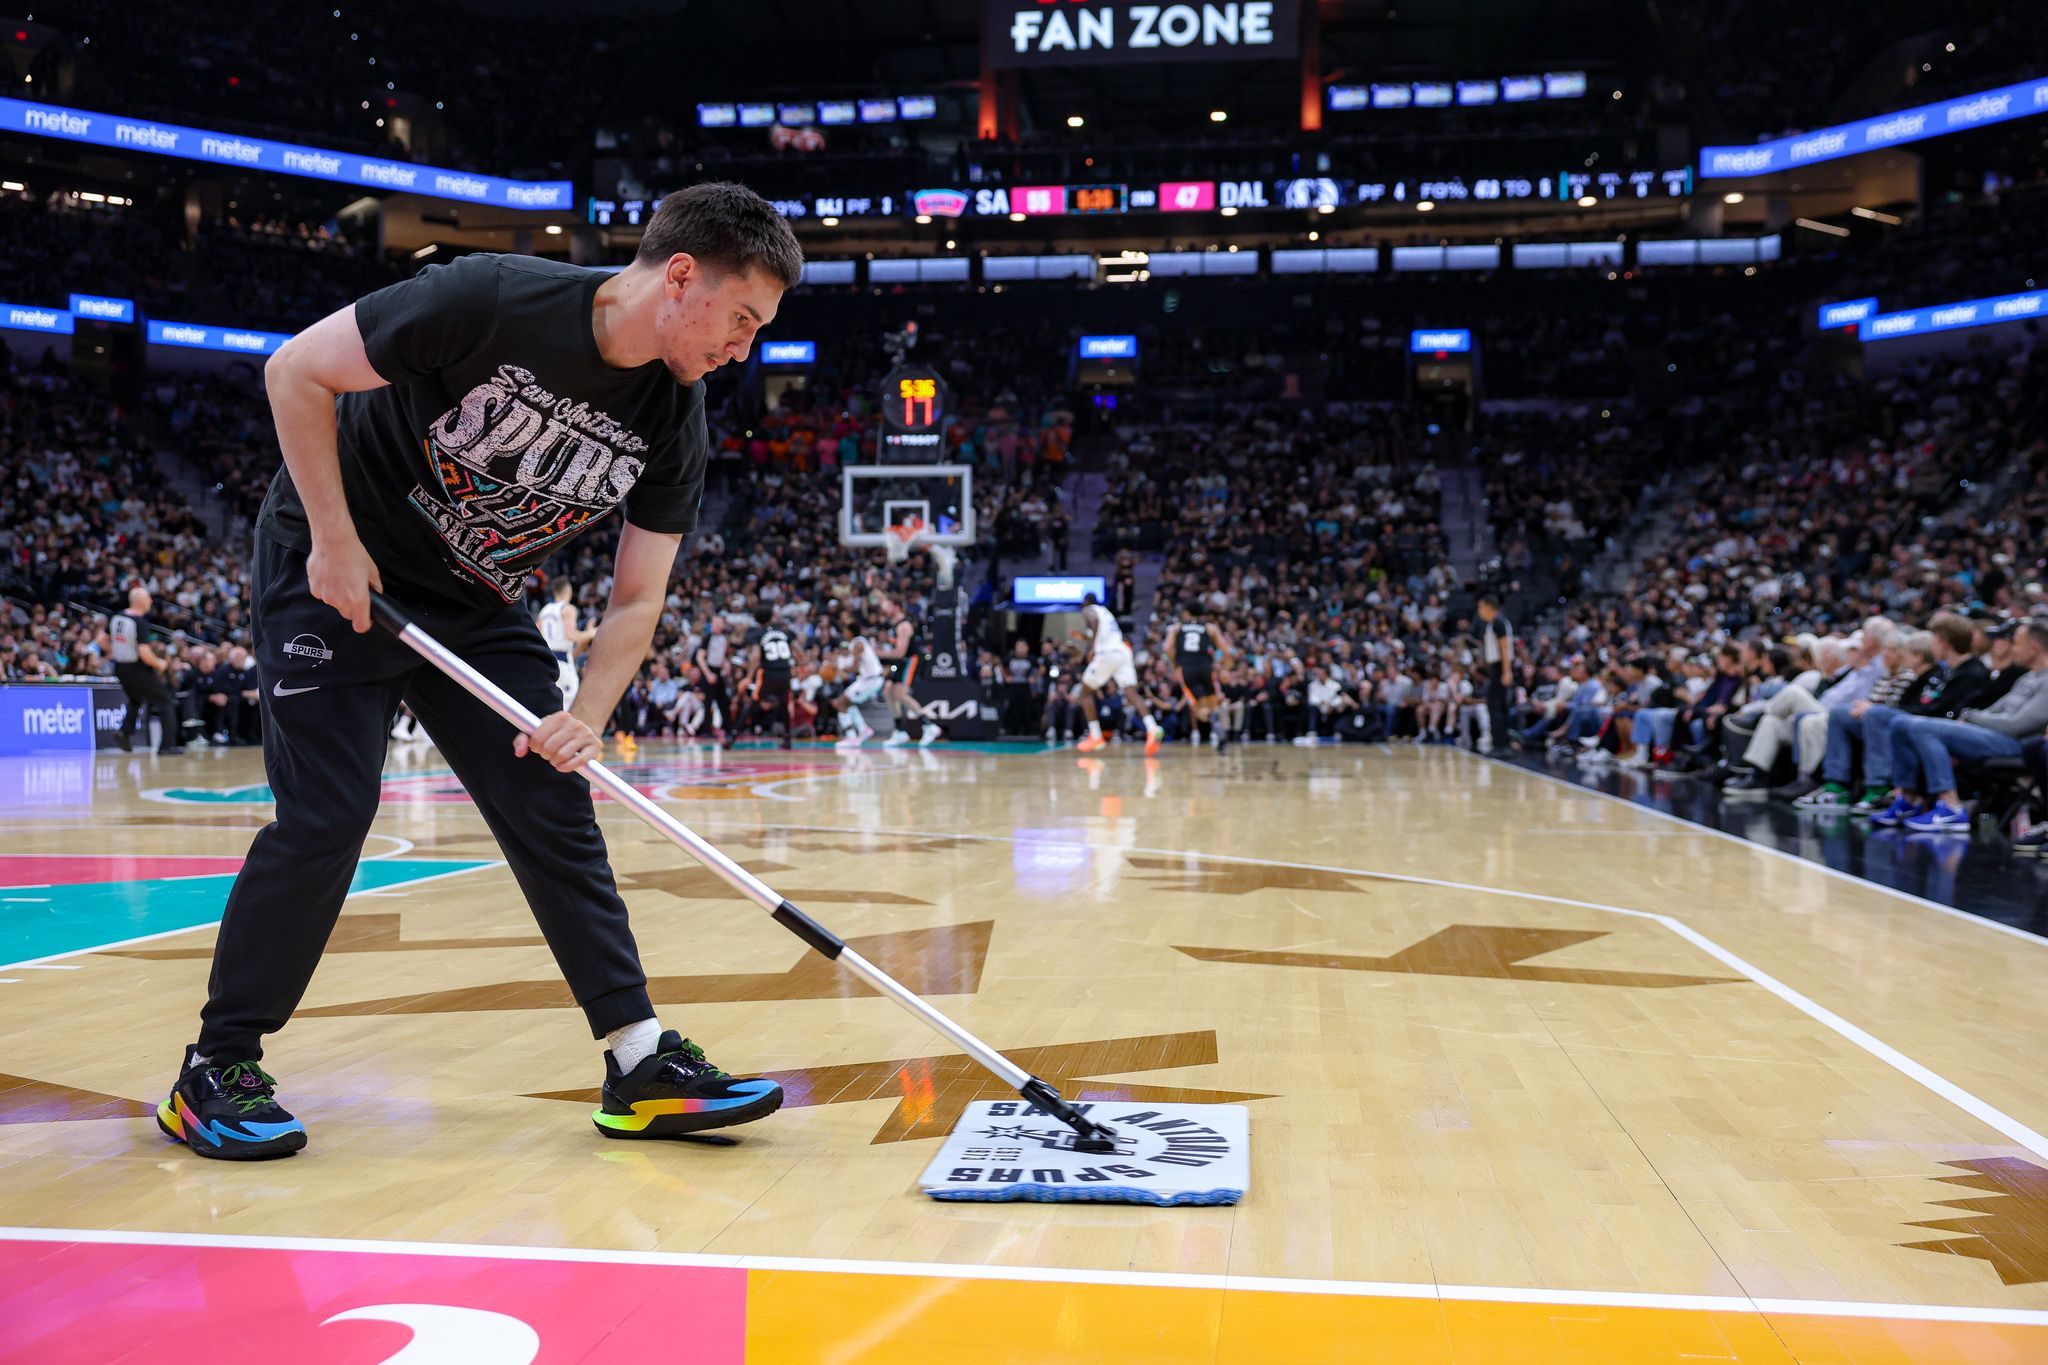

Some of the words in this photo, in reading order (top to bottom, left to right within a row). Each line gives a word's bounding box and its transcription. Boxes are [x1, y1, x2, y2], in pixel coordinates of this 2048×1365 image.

[1010, 8, 1114, 53] FAN
[1127, 3, 1274, 48] ZONE
[1713, 149, 1773, 173] meter
[1790, 132, 1848, 161] meter
[1865, 114, 1927, 144] meter
[1947, 94, 2011, 126] meter
[25, 108, 92, 135] meter
[116, 123, 178, 149] meter
[200, 137, 262, 162] meter
[282, 150, 341, 175] meter
[361, 163, 417, 186] meter
[435, 174, 489, 198] meter
[506, 186, 559, 205] meter
[846, 199, 871, 215] PF
[975, 188, 1010, 215] SA
[1174, 185, 1200, 209] 47
[1220, 181, 1269, 209] DAL
[10, 309, 58, 328] meter
[79, 300, 125, 318] meter
[162, 326, 207, 344] meter
[223, 332, 266, 350] meter
[489, 363, 557, 409] San
[553, 397, 649, 453] Antonio
[905, 397, 933, 427] 17
[428, 382, 647, 505] SPURS
[290, 644, 324, 658] SPURS
[761, 640, 791, 661] 30
[1183, 631, 1201, 653] 2
[23, 701, 86, 735] meter
[1110, 1110, 1232, 1168] ANTONIO
[947, 1163, 1158, 1183] SPURS
